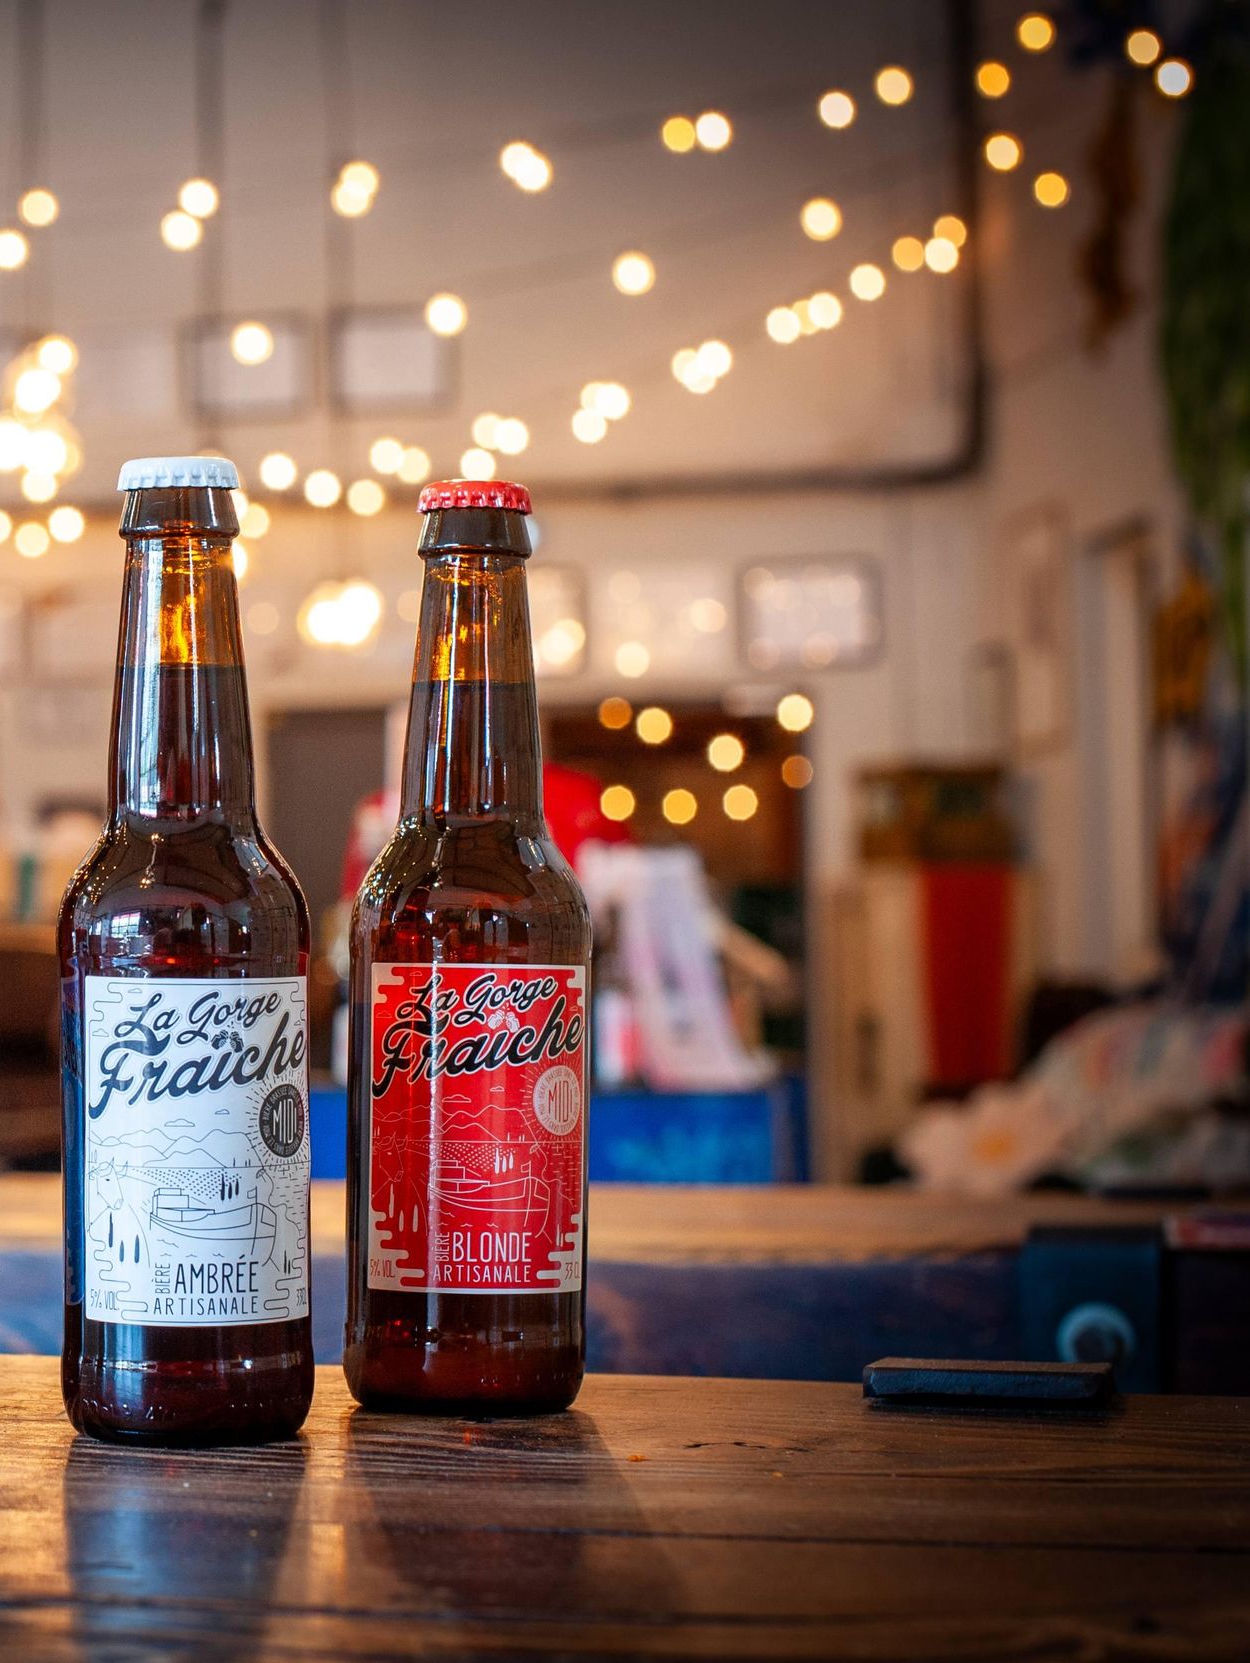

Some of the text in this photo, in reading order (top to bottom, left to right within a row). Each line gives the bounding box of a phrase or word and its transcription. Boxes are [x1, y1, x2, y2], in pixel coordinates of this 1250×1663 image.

[114, 991, 281, 1045] La Gorge
[397, 973, 557, 1025] La Gorge
[272, 1098, 297, 1144] MIDI
[548, 1080, 573, 1122] MIDI
[453, 1231, 532, 1263] BLONDE
[174, 1254, 259, 1294] AMBRÉE
[432, 1264, 531, 1283] ARTISANALE
[153, 1296, 259, 1316] ARTISANALE
